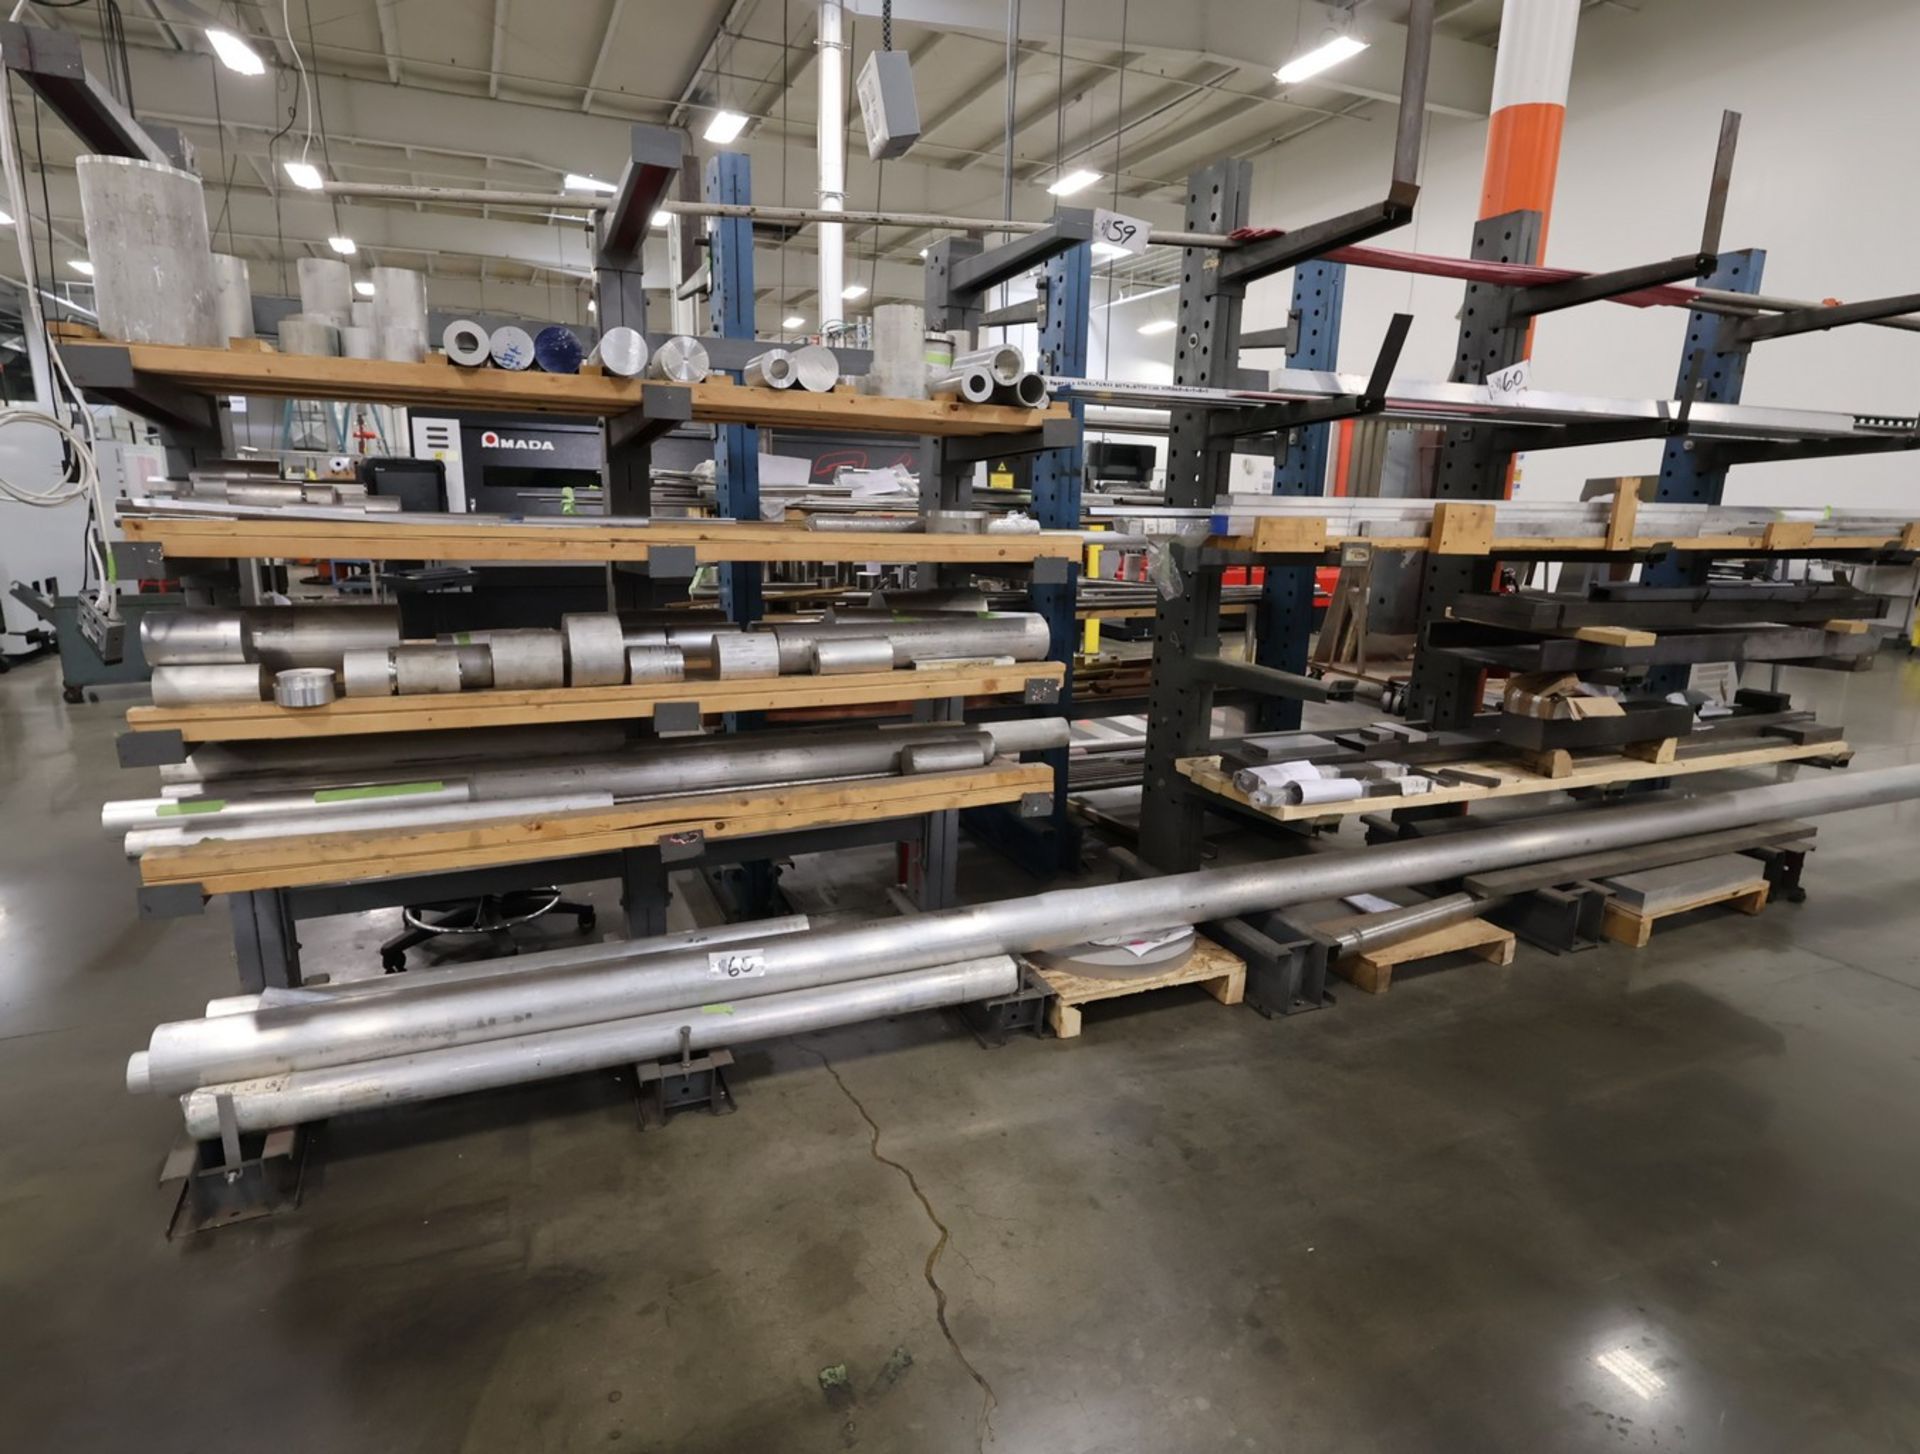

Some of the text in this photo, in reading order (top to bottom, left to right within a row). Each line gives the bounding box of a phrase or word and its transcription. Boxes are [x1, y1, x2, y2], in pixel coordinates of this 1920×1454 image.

[1107, 220, 1137, 245] 59
[1503, 370, 1523, 393] 60
[481, 431, 555, 451] AMADA
